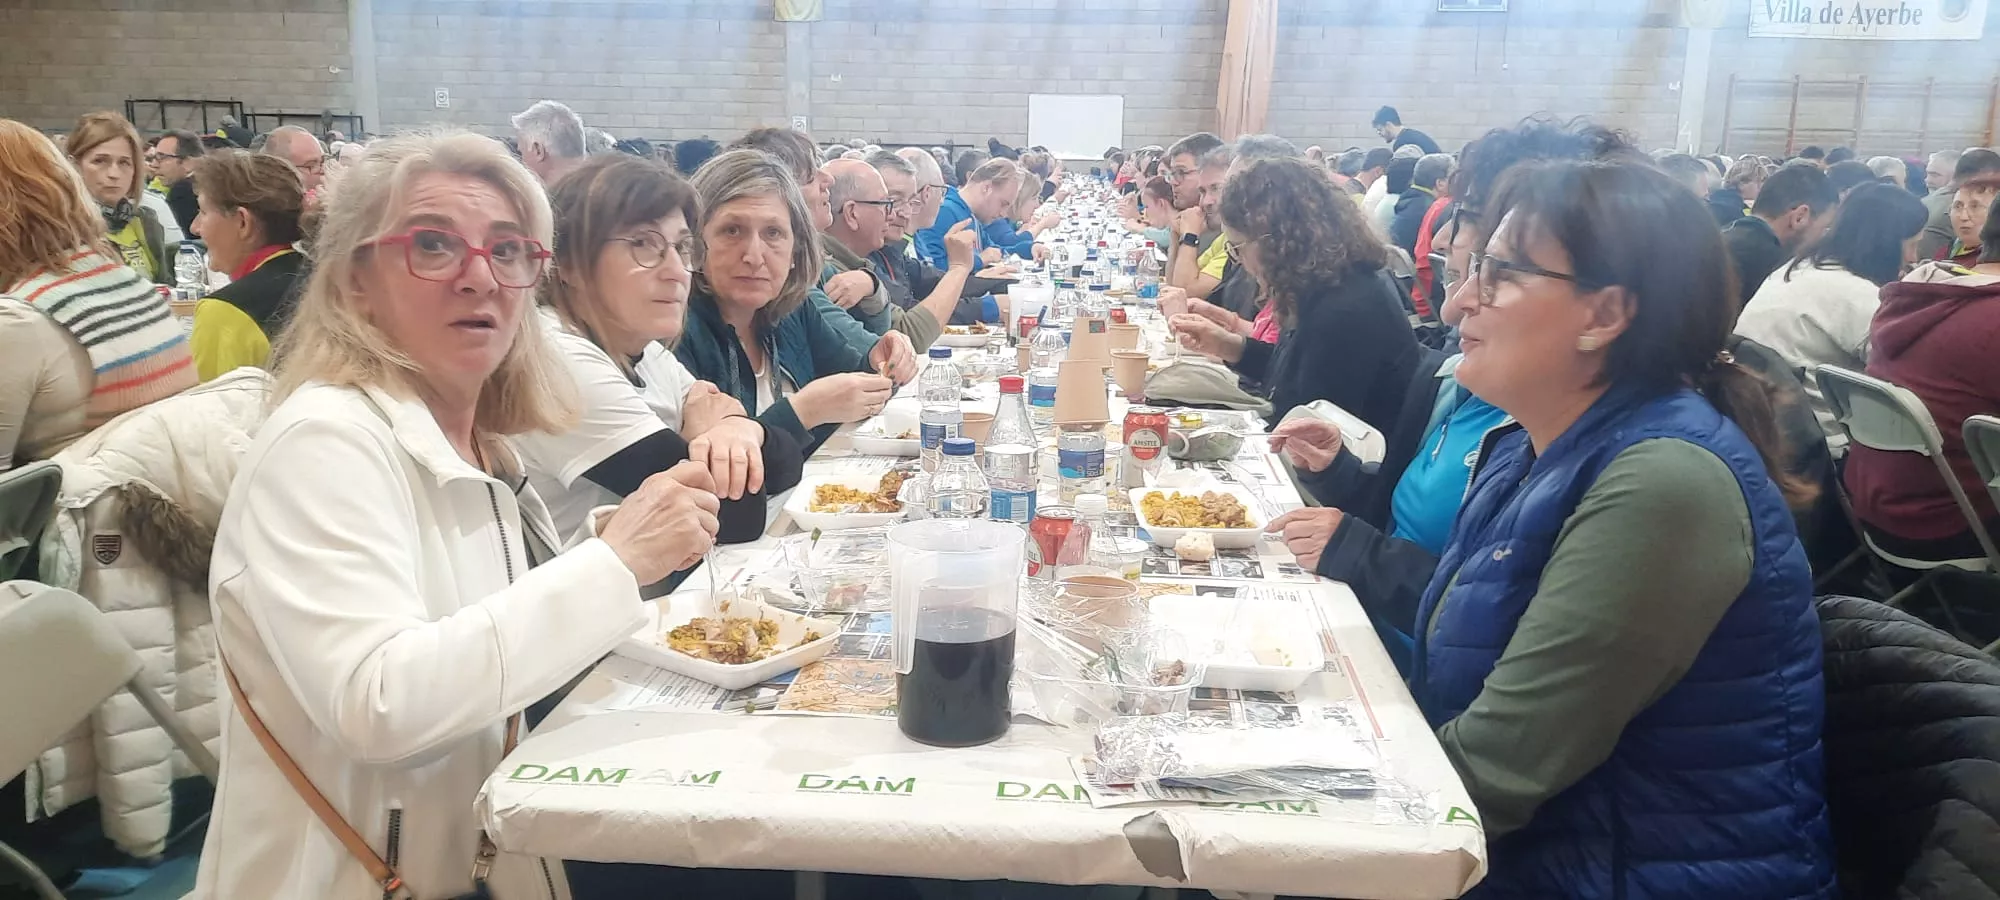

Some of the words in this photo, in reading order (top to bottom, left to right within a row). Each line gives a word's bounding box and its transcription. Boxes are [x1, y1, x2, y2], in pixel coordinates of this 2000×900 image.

[1765, 0, 1812, 24] Villa
[1819, 0, 1844, 25] de
[1848, 0, 1923, 32] Ayerbe
[508, 763, 633, 784] DAM
[797, 773, 917, 794] DAM
